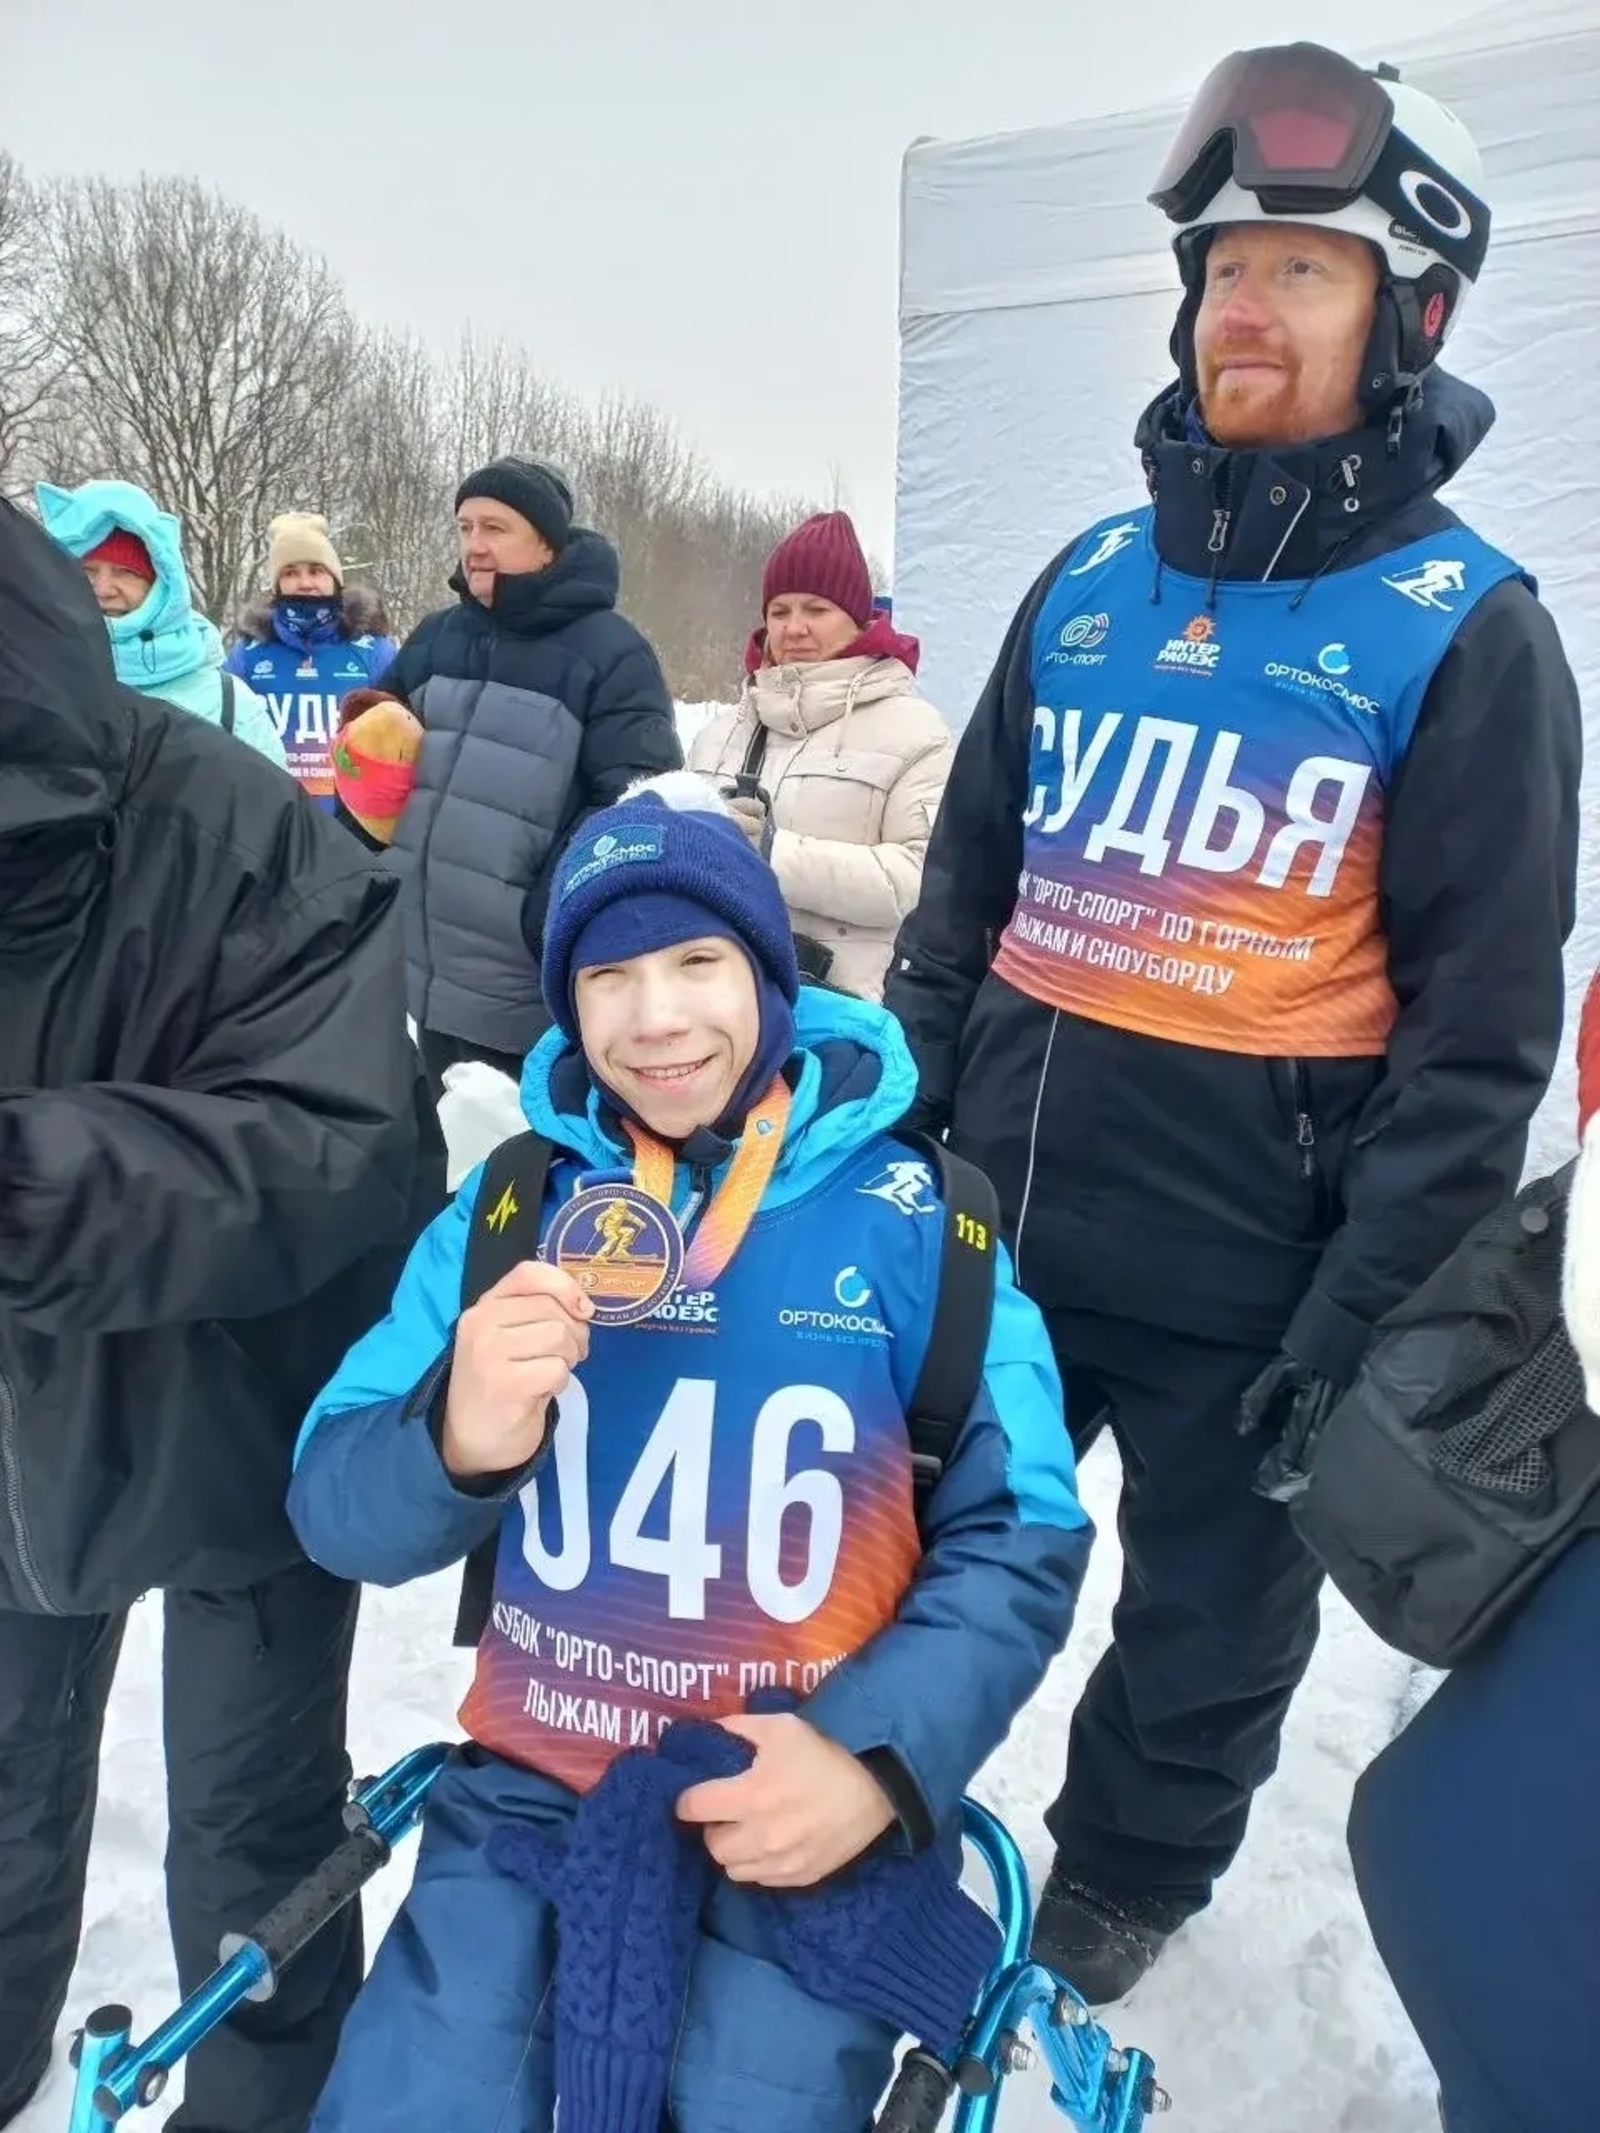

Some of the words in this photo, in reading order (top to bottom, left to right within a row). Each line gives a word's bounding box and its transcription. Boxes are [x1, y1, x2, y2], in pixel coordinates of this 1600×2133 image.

[1045, 652, 1107, 665] РТО-СПОРТ
[1164, 639, 1220, 655] ИНТЕР
[1265, 662, 1380, 715] ОРТОКОСМОС
[1022, 706, 1372, 898] СУДЬЯ
[1032, 875, 1156, 931] "ОРТО-СПОРТ"
[1159, 911, 1193, 943] ПО
[1200, 921, 1315, 961] ГОРНЫМ
[1071, 933, 1085, 959] И
[1087, 938, 1235, 996] СНОУБОРДУ
[956, 1213, 986, 1251] 113
[678, 1305, 719, 1323] ЕЭС
[519, 1374, 856, 1624] 046
[493, 1600, 541, 1658] КУБОК
[546, 1626, 729, 1700] "ОРТО-СПОРТ"
[738, 1660, 777, 1697] ПО
[785, 1652, 847, 1694] ГОР
[524, 1678, 622, 1744] ЛЫЖАМ
[630, 1710, 650, 1745] И
